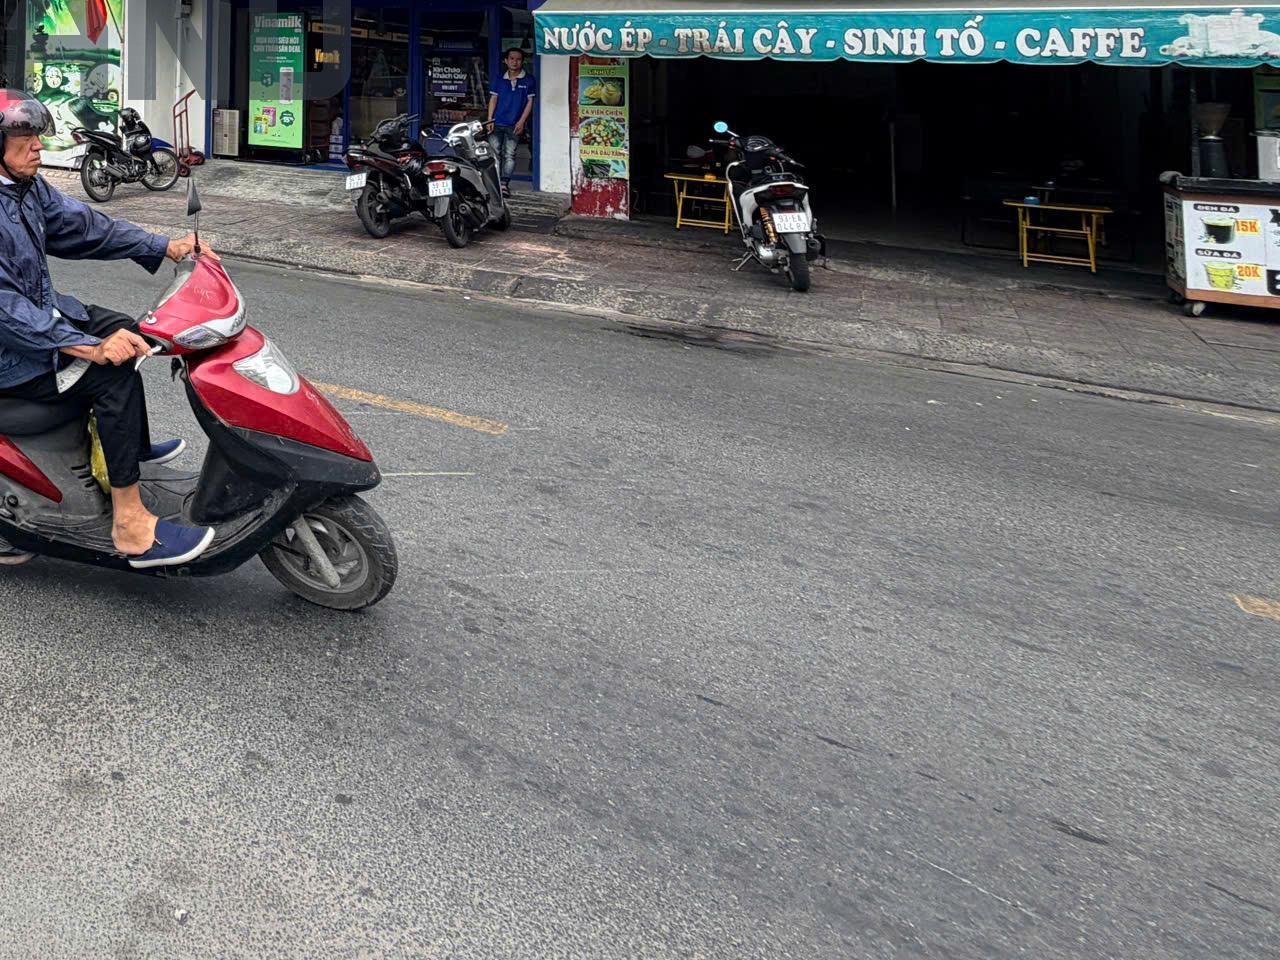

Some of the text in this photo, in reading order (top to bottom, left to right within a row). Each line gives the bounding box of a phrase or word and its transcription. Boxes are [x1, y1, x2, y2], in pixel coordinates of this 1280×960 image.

[542, 14, 1147, 58] NƯỚC ÉP TRÁI CÂY SINH TỐ CAFFE
[1236, 221, 1259, 233] 15K
[1237, 265, 1261, 278] 20K
